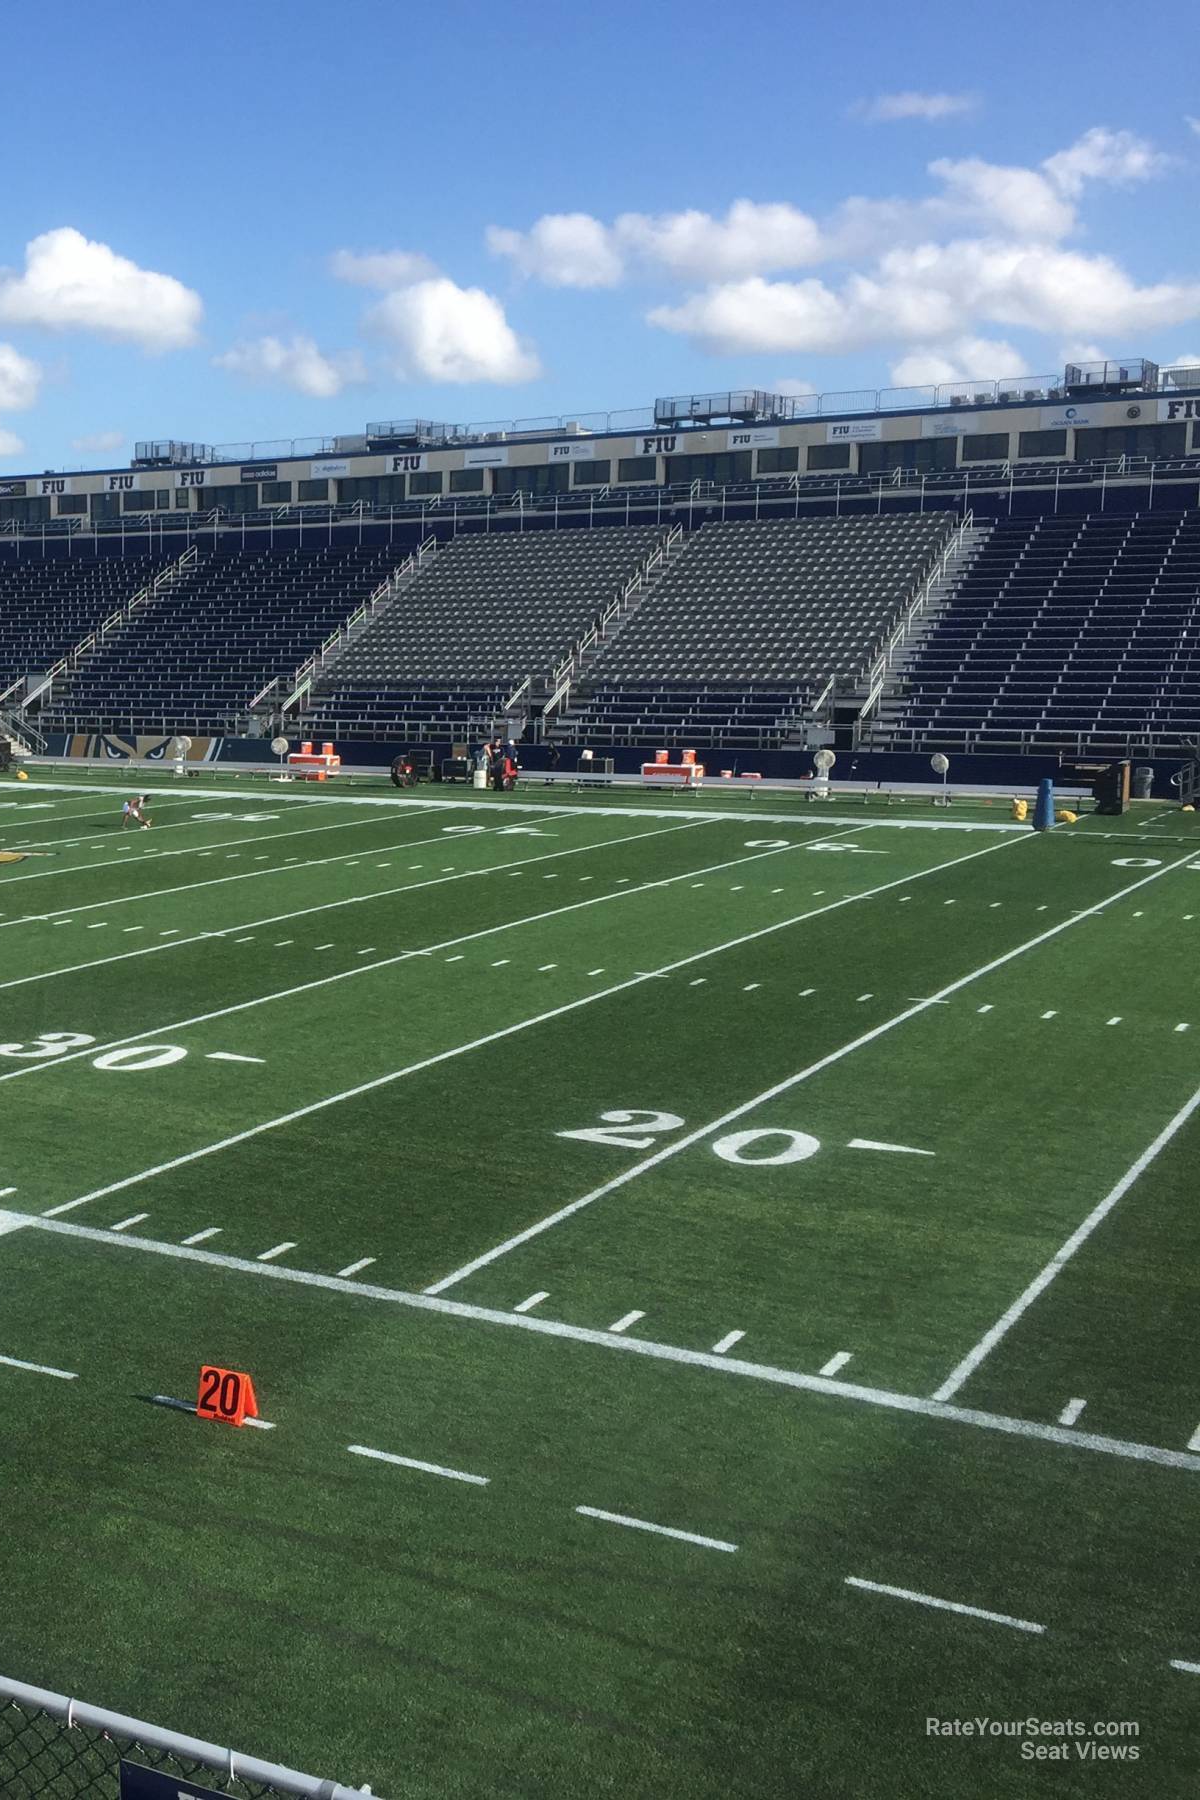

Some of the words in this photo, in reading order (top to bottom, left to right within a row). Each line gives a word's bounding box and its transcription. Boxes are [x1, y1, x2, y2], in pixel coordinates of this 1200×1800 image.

[1168, 400, 1200, 419] FI
[832, 425, 851, 435] FIU
[643, 436, 677, 454] FIU
[732, 434, 751, 445] FIU
[553, 446, 570, 456] FIU
[392, 455, 422, 471] FIU
[109, 475, 135, 490] FIU
[180, 470, 205, 487] FIU
[42, 480, 66, 494] FIU
[554, 1110, 820, 1165] 20
[200, 1369, 240, 1416] 20
